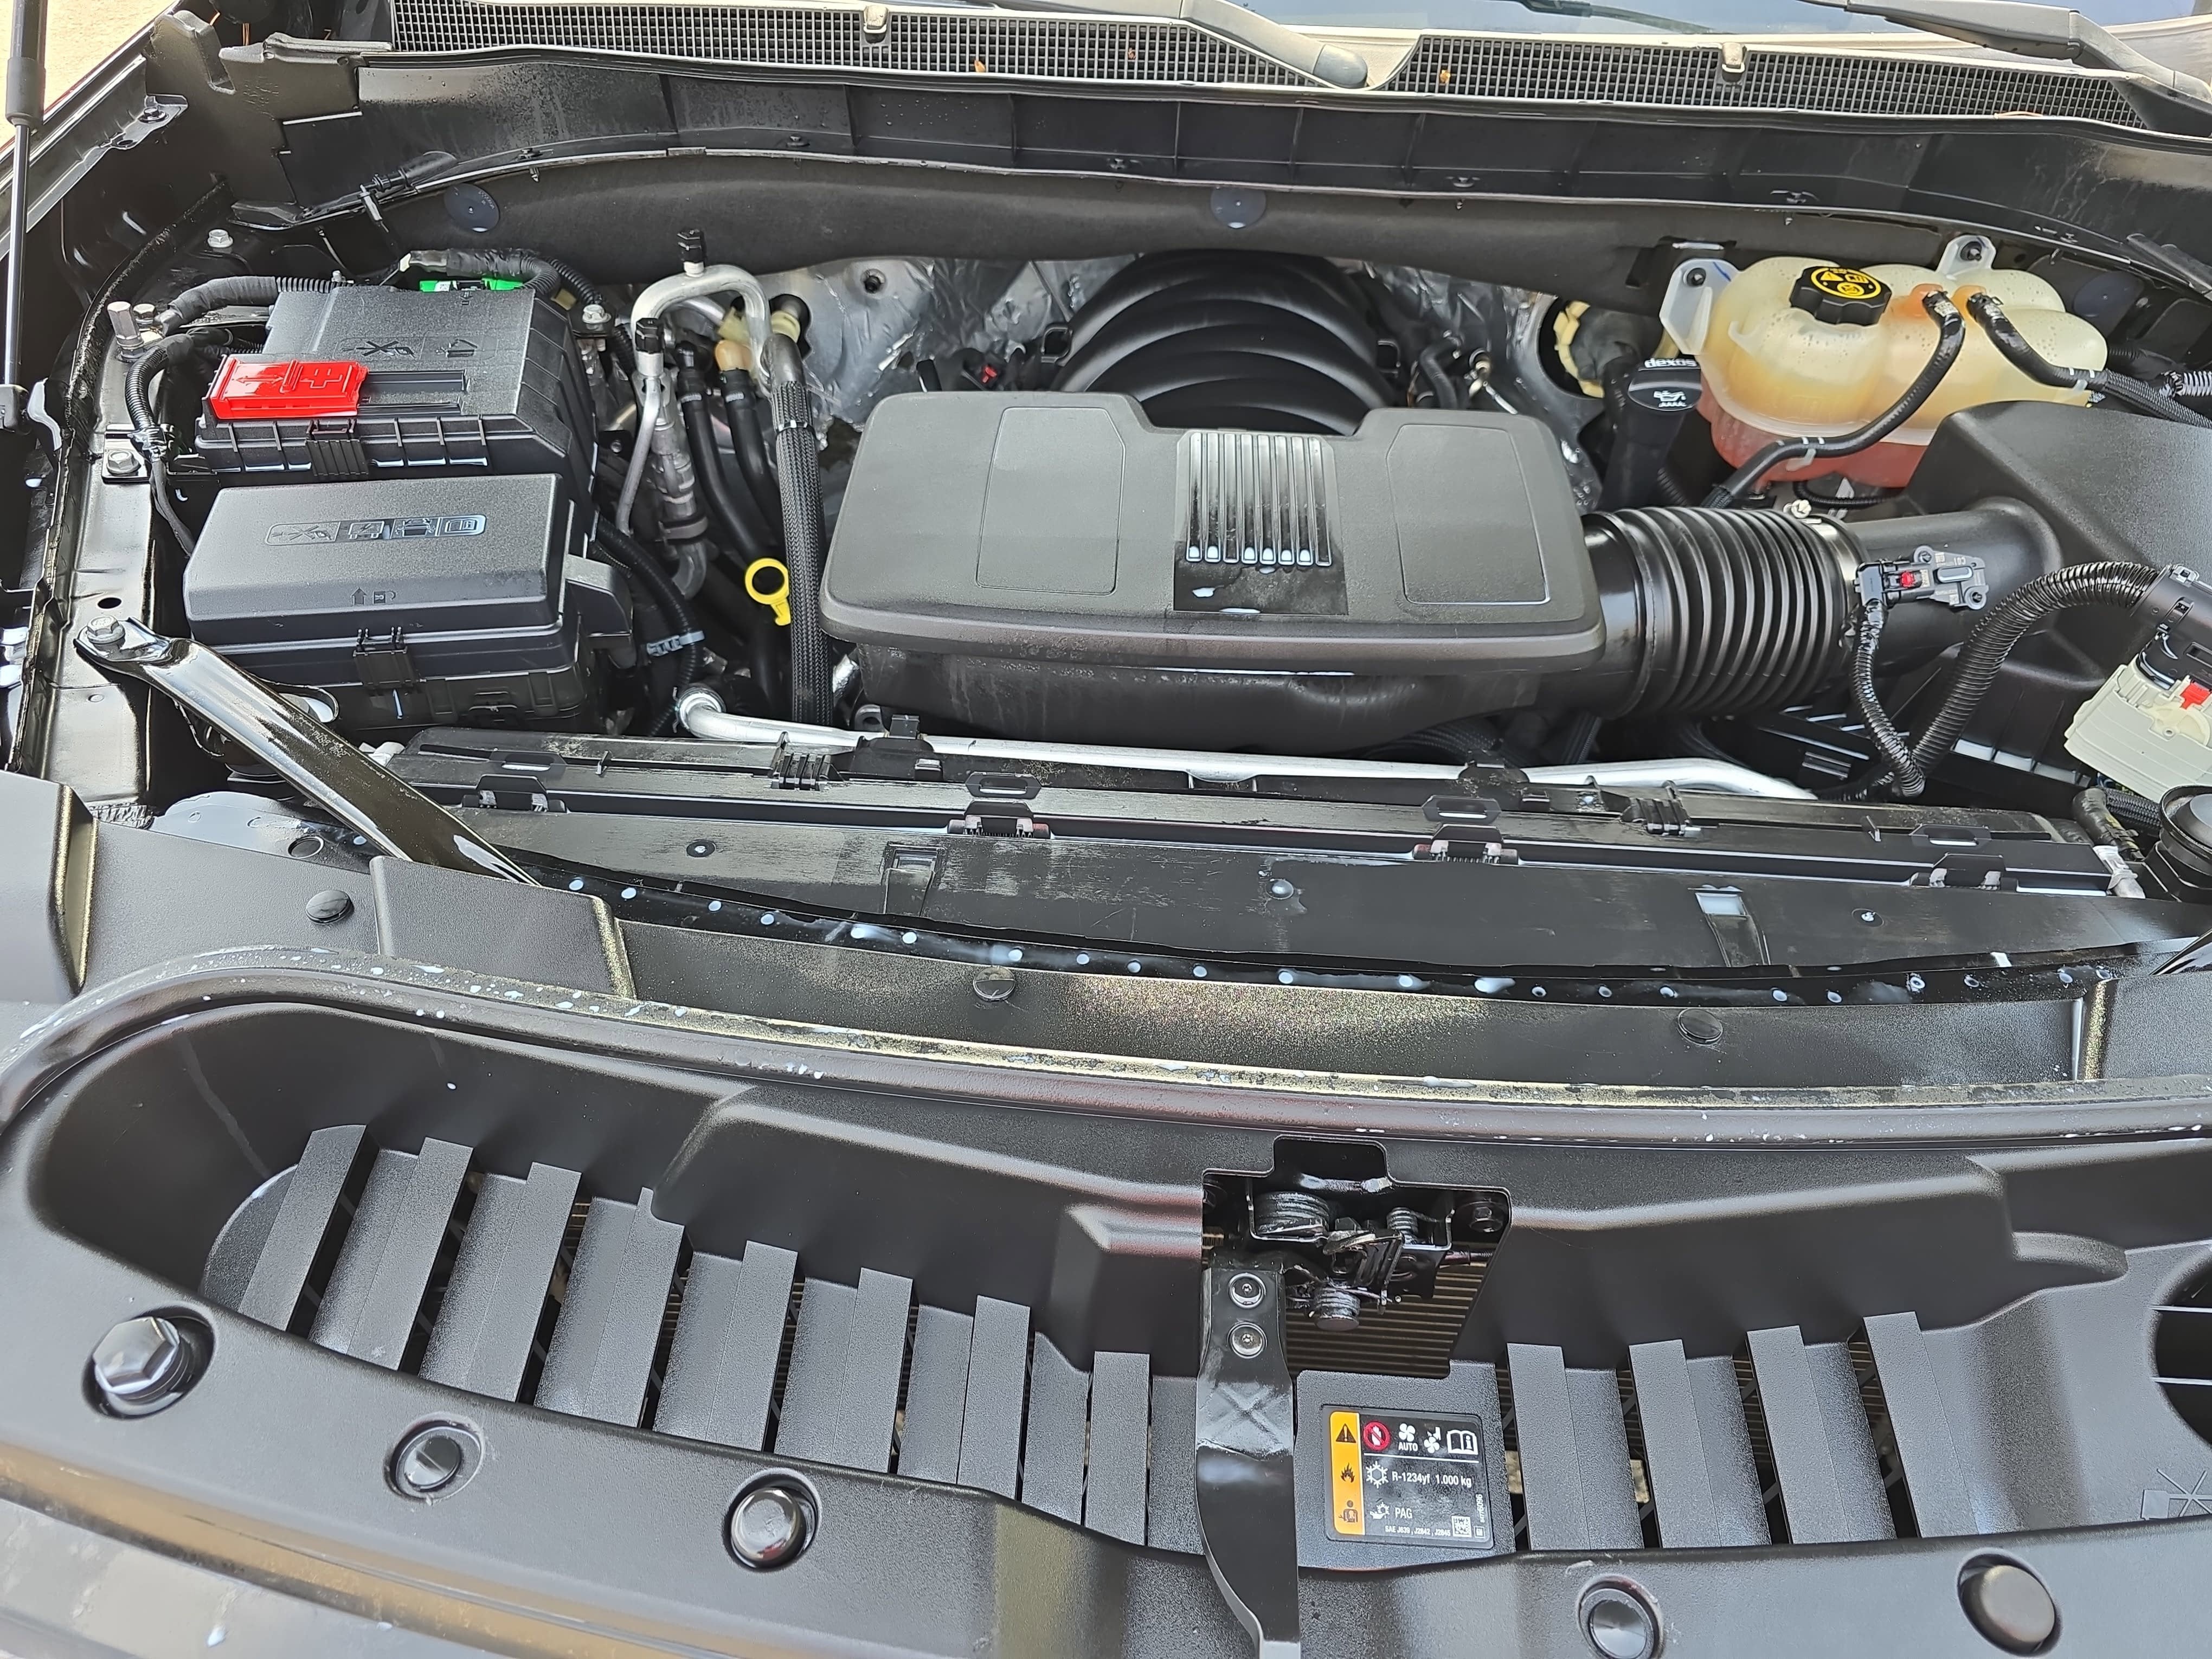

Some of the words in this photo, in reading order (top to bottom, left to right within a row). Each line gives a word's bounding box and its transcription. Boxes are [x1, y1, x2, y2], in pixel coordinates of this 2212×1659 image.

[1644, 358, 1697, 368] dexos
[1398, 1442, 1418, 1452] AUTO
[1392, 1471, 1430, 1485] R-1234yf
[1435, 1474, 1459, 1485] 1.000
[1461, 1475, 1471, 1488] kg
[1395, 1507, 1413, 1519] PAG
[1385, 1525, 1396, 1533] SAE
